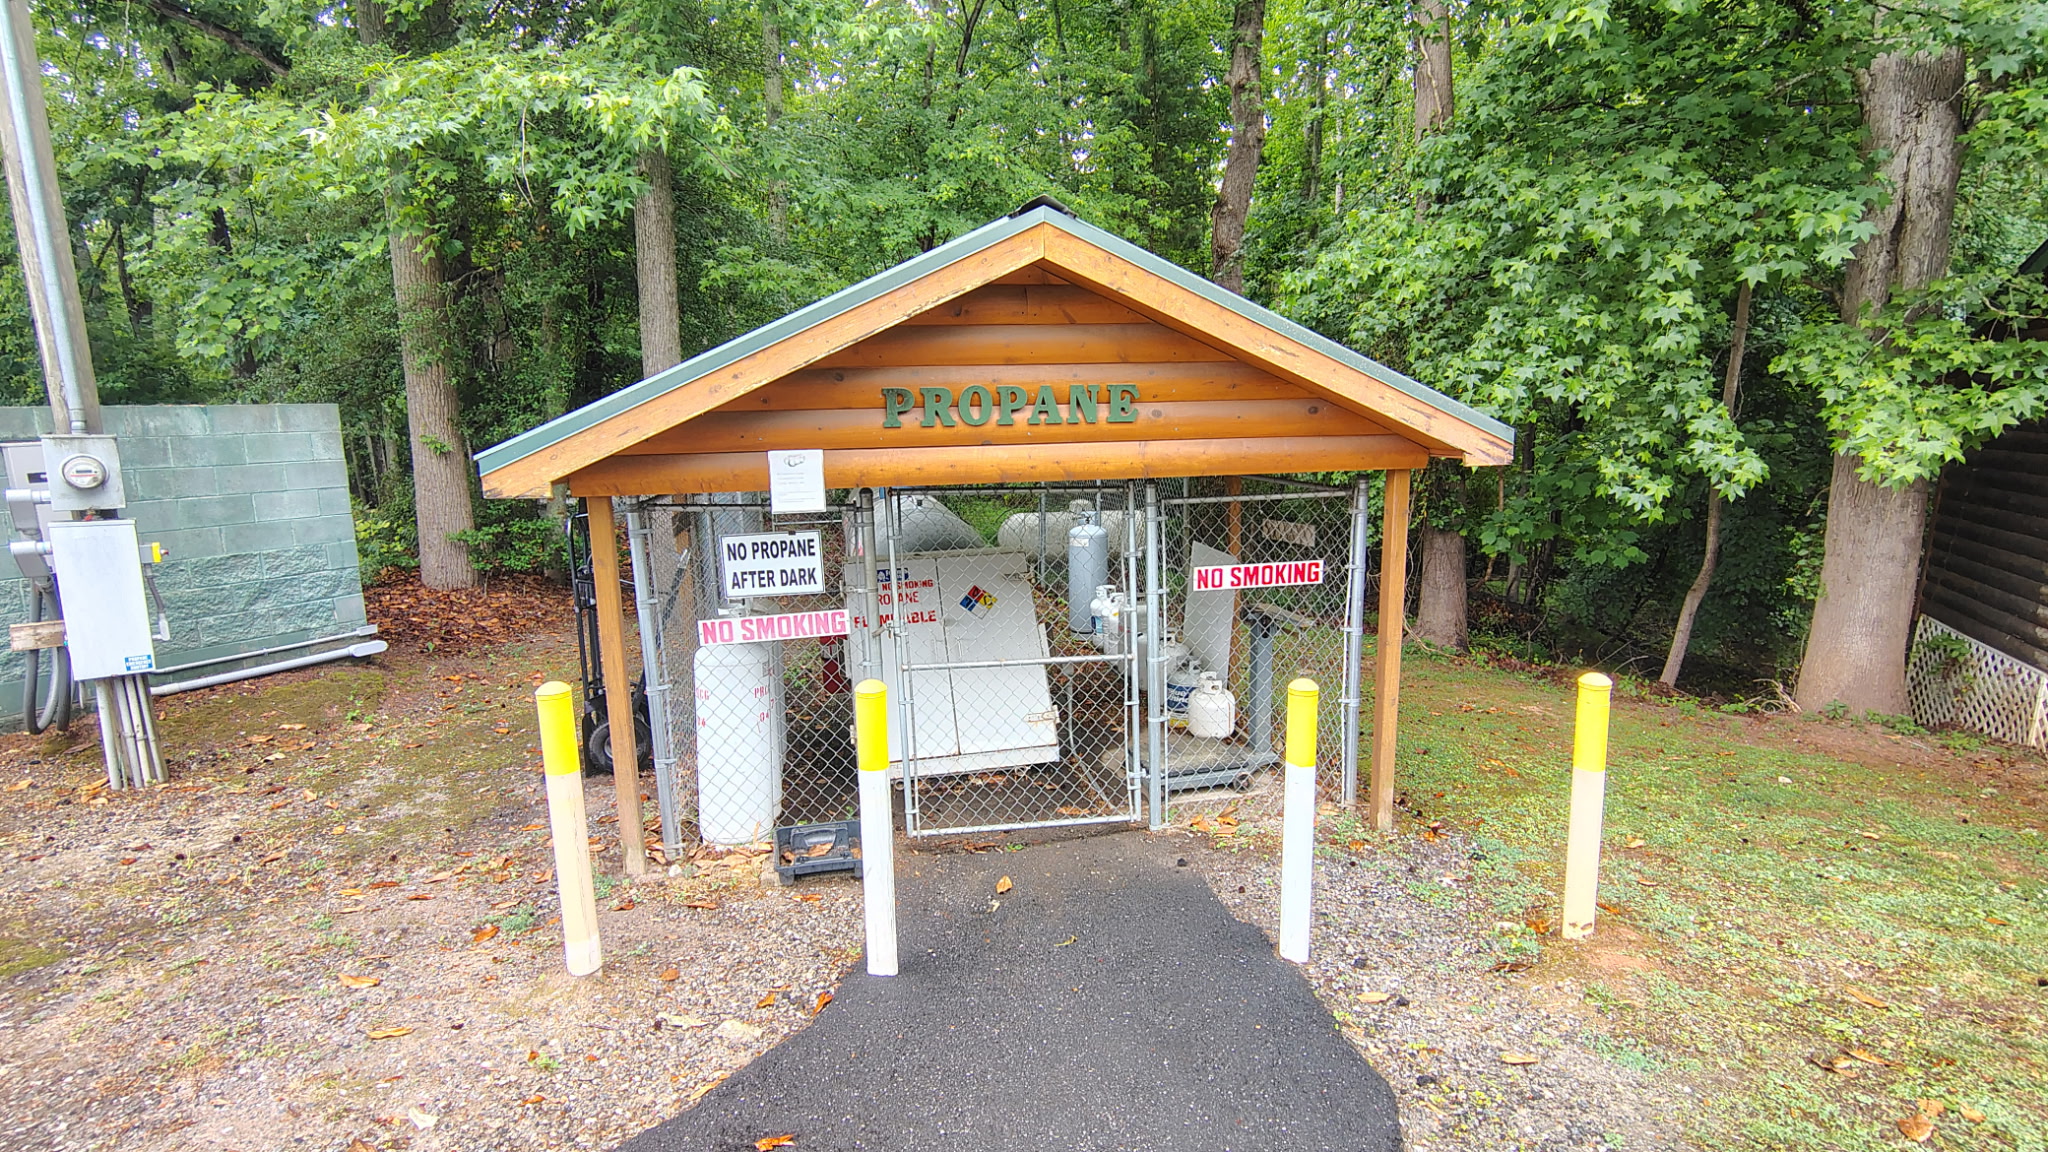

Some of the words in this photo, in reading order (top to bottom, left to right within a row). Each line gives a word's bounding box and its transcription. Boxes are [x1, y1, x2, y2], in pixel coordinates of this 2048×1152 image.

[881, 384, 1141, 428] PROPANE
[726, 542, 747, 561] NO
[751, 538, 816, 560] PROPANE
[731, 569, 776, 590] AFTER
[780, 567, 818, 587] DARK
[1197, 568, 1223, 589] NO
[1230, 561, 1320, 587] SMOKING
[702, 620, 734, 644] NO
[740, 611, 847, 641] SMOKING
